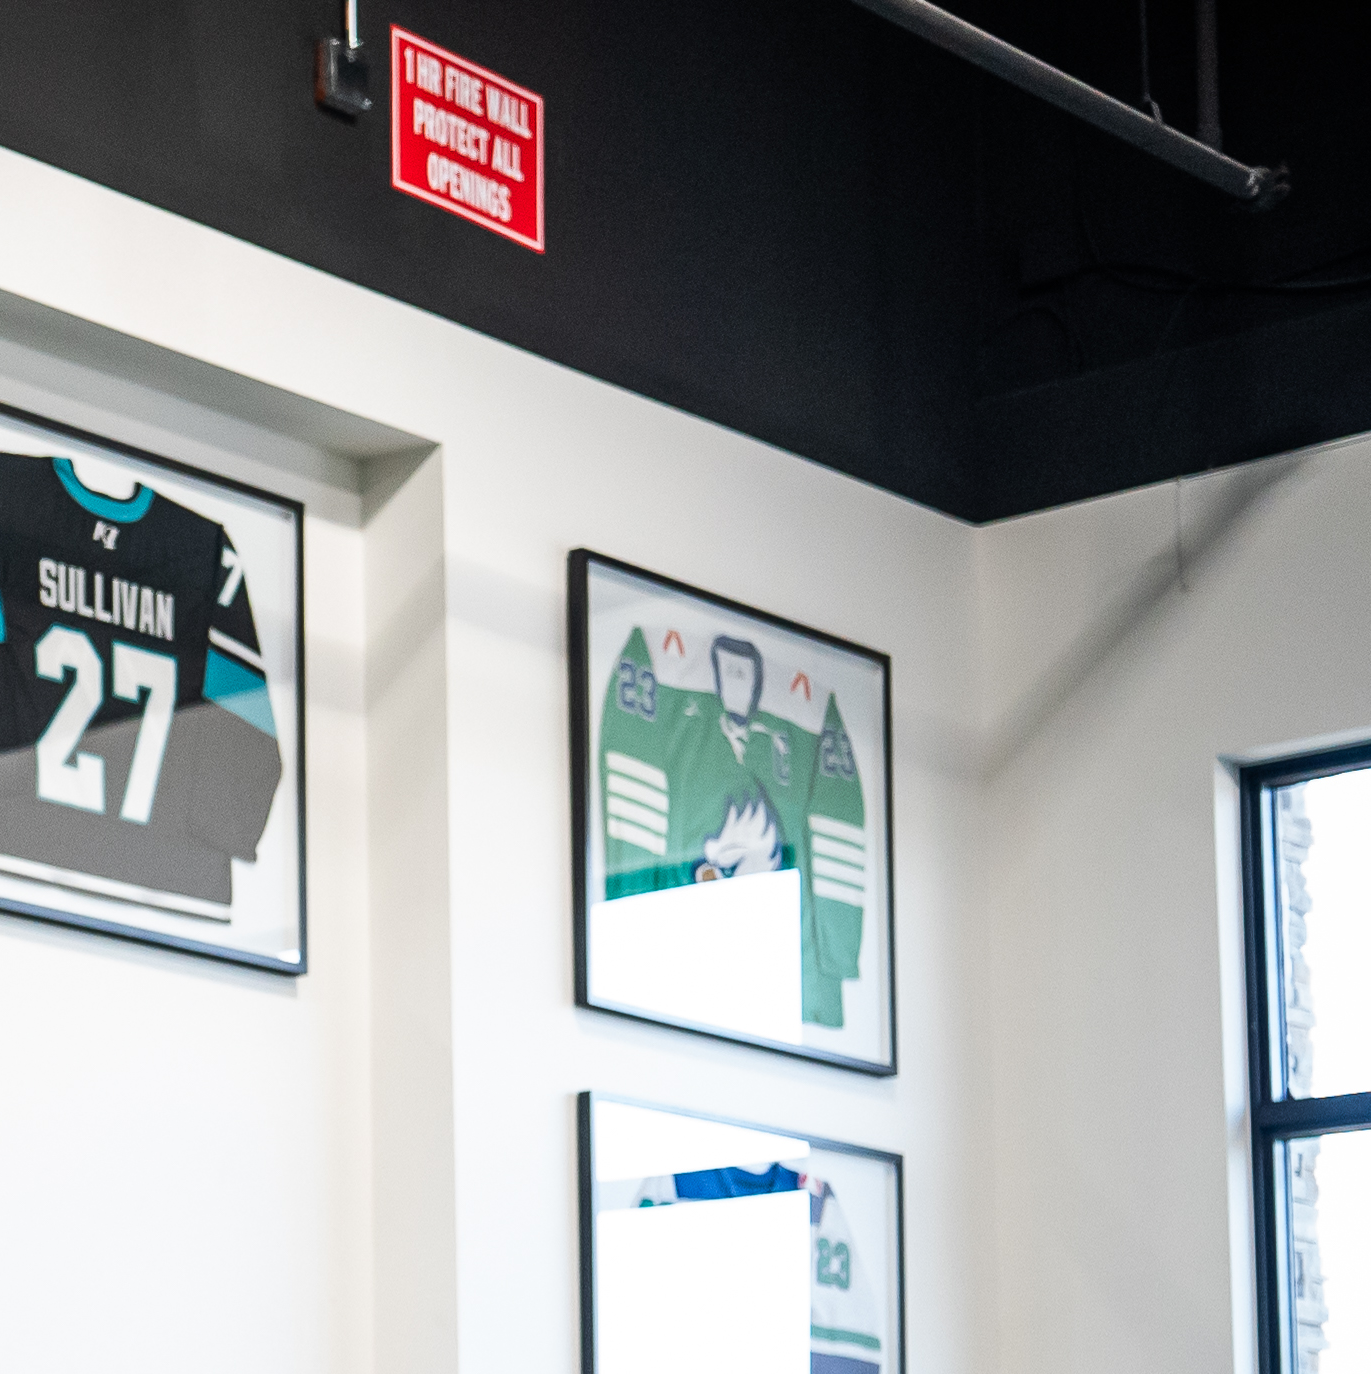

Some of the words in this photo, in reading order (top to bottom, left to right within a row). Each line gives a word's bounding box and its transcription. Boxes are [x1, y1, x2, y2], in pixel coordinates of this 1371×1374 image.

[413, 97, 490, 166] PROTECT
[491, 135, 525, 183] ALL
[444, 64, 484, 118] FIRE
[485, 83, 533, 140] WALL
[426, 152, 513, 223] OPENINGS
[38, 557, 175, 641] SULLIVAN
[33, 623, 179, 825] 27
[616, 659, 657, 722] 23
